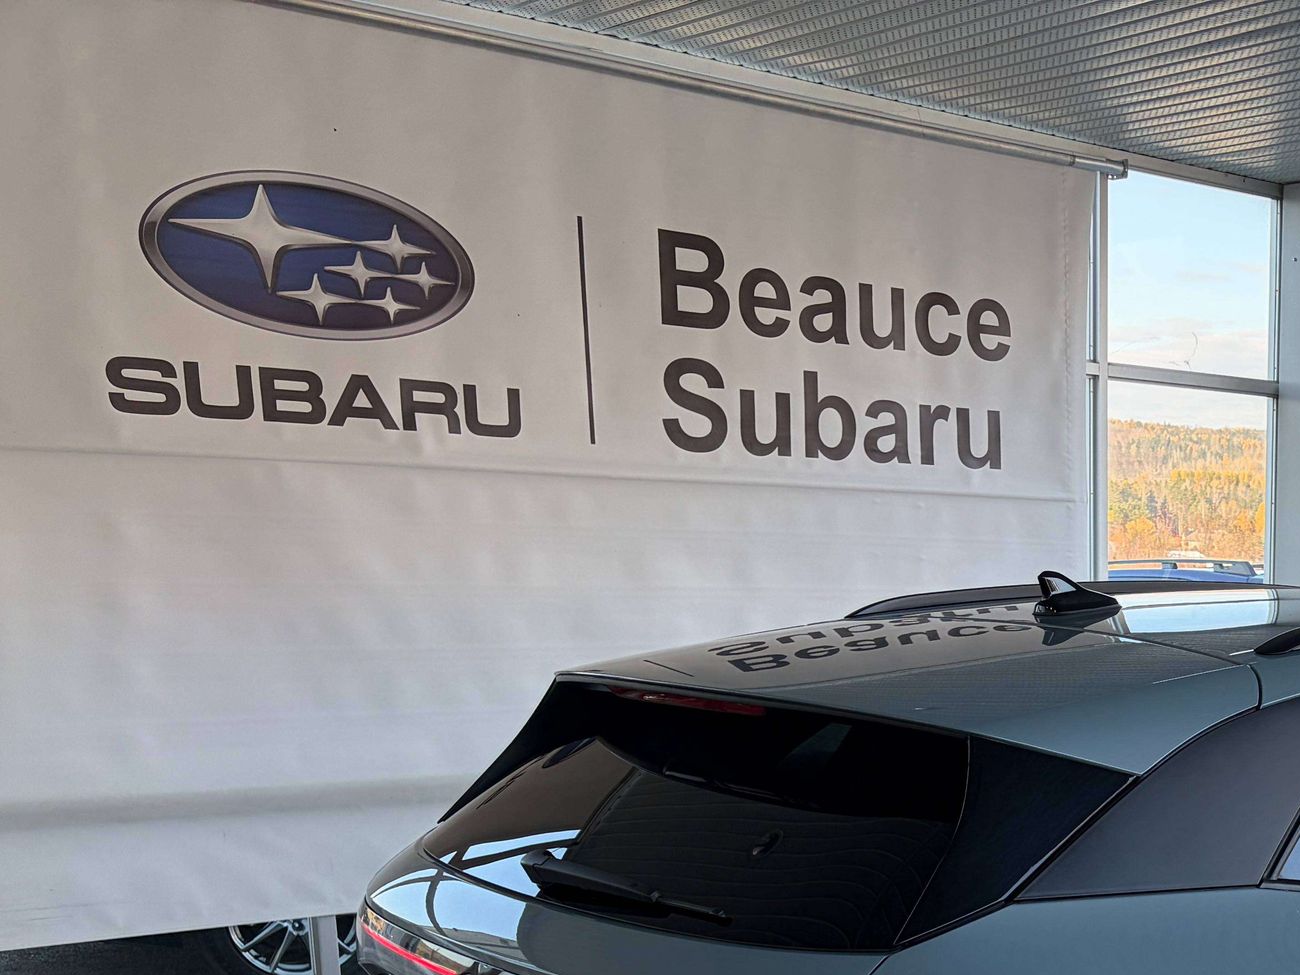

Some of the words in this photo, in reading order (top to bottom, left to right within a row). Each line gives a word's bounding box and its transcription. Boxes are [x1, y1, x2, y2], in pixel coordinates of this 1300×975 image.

[657, 227, 1011, 362] Beauce
[105, 356, 522, 438] SUBARU
[662, 357, 1002, 470] Subaru
